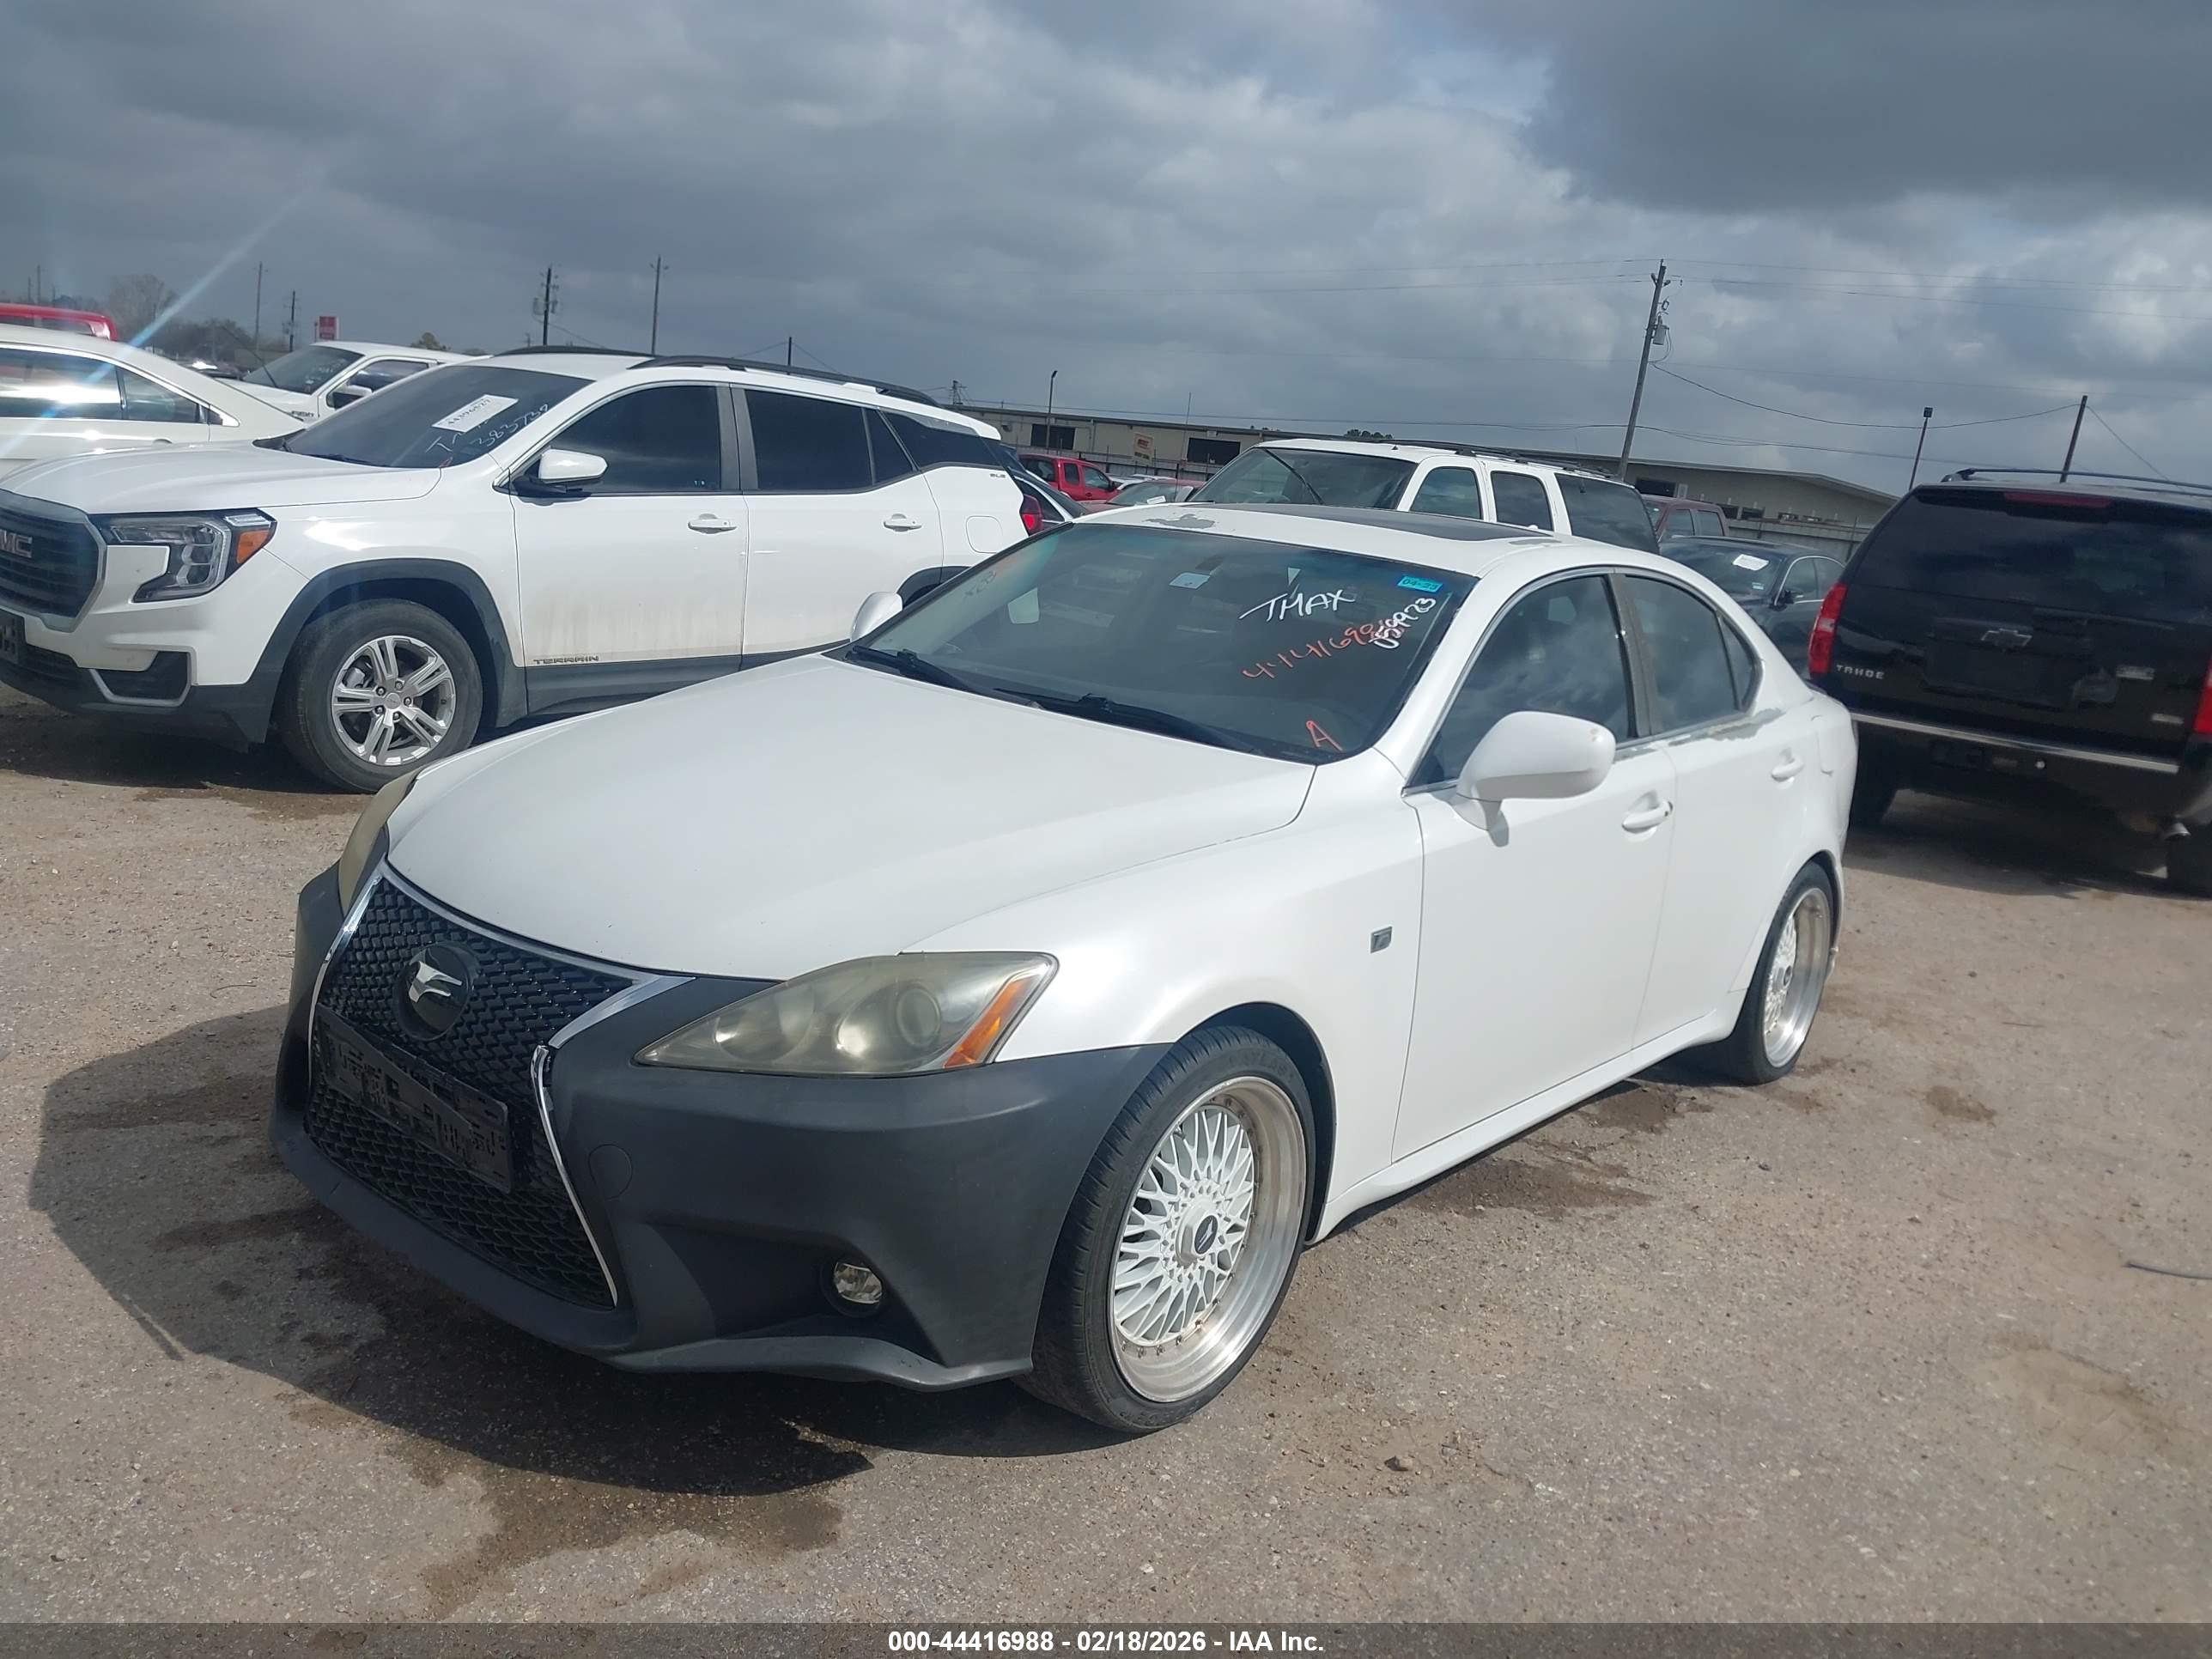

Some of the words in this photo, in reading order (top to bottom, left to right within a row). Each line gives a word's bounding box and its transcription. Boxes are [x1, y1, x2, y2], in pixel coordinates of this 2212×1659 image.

[1239, 589, 1356, 622] TMAX
[532, 655, 599, 665] TERRAIN
[1836, 664, 1885, 679] TAHOE
[1305, 720, 1343, 751] A
